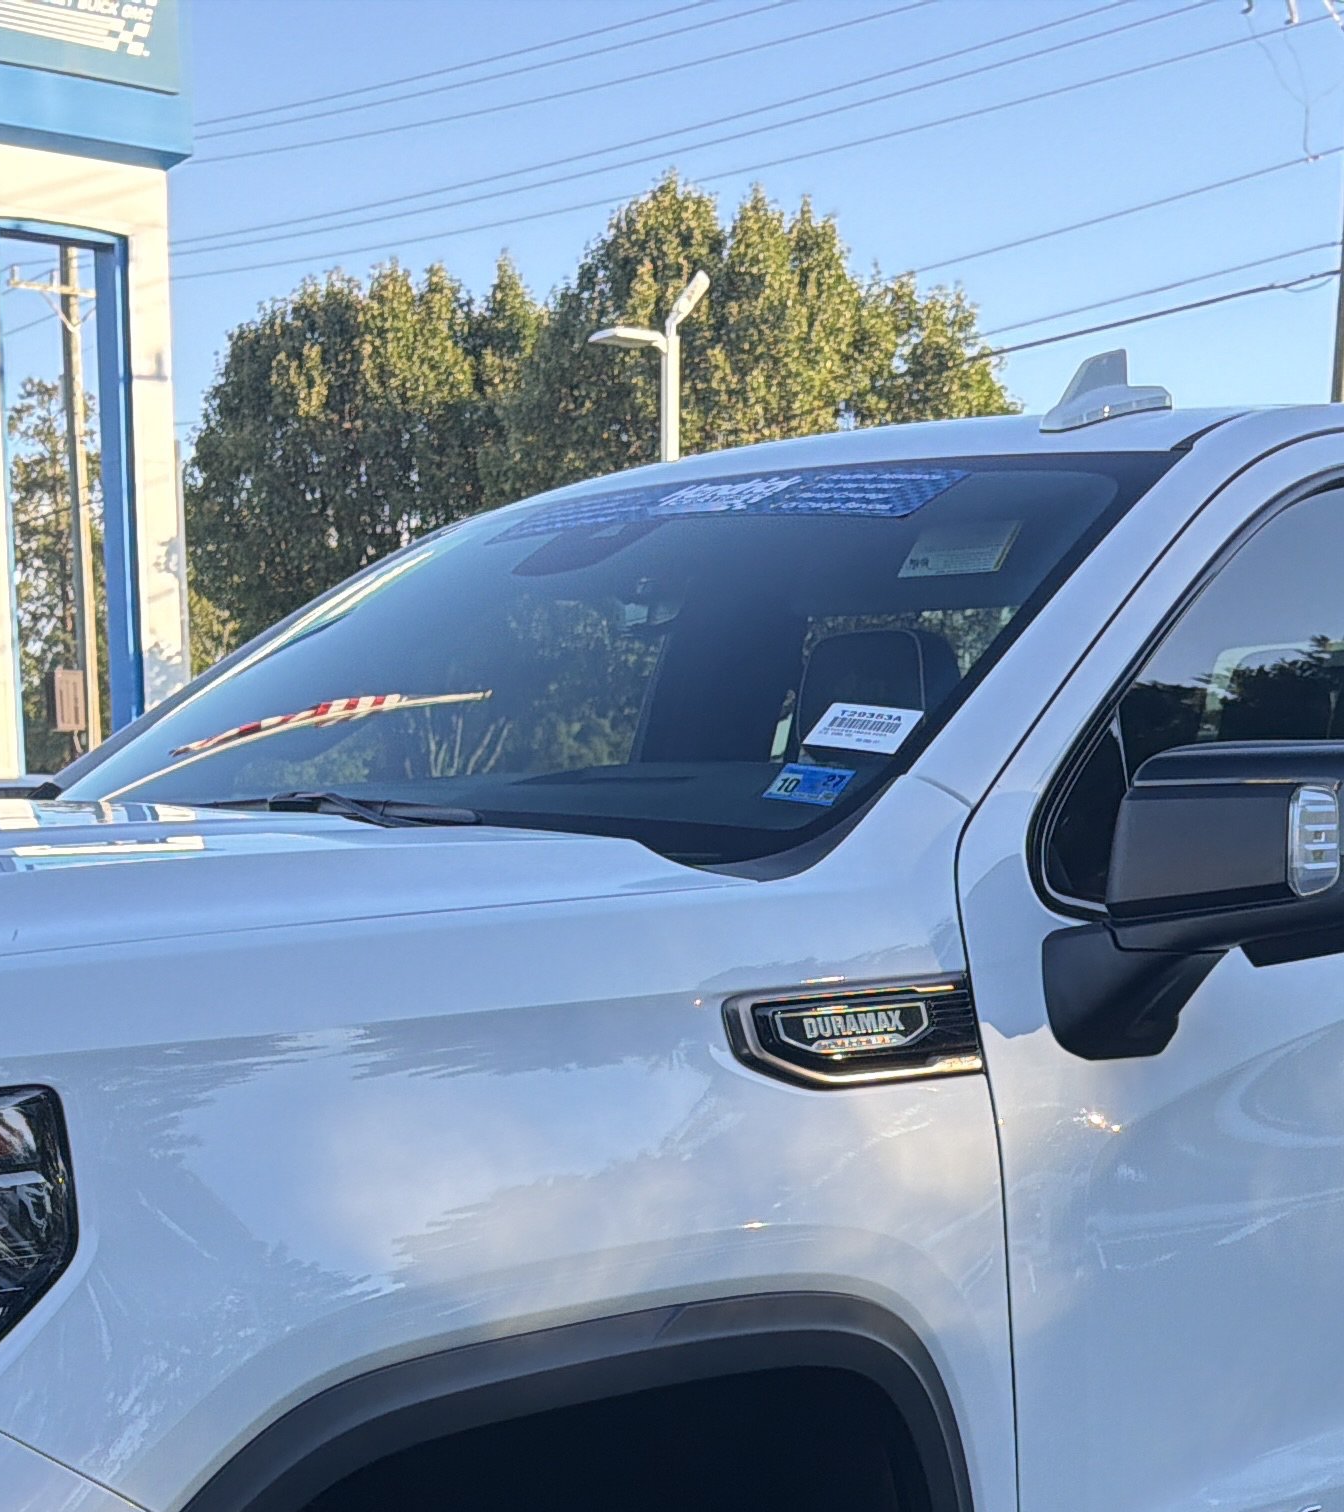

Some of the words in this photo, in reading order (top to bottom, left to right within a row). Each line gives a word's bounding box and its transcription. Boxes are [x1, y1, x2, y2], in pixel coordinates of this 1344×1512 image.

[121, 4, 154, 22] GMC
[777, 777, 801, 793] 10
[802, 1010, 906, 1039] DURAMAX
